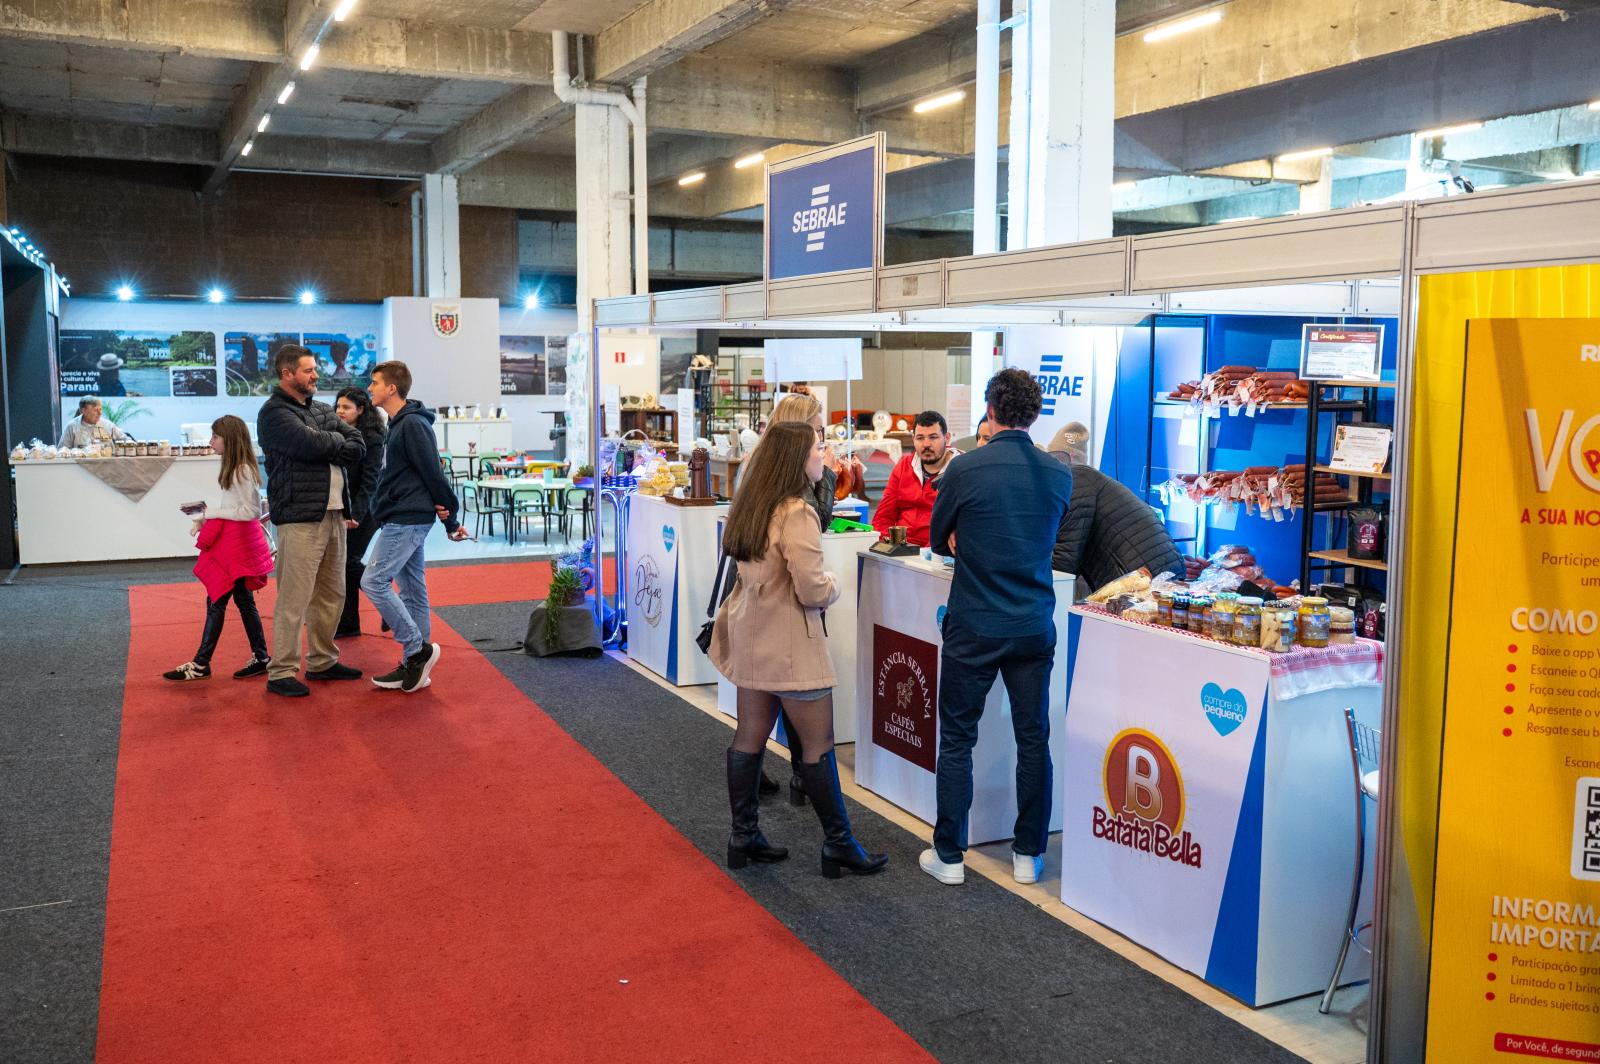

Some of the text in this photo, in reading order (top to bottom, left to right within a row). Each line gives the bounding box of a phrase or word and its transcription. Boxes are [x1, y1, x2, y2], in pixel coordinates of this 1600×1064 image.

[792, 202, 847, 233] SEBRAE
[1581, 344, 1600, 362] R
[60, 382, 99, 392] Paraná
[1031, 375, 1084, 396] BRAE
[1520, 508, 1531, 524] A
[1538, 508, 1567, 525] SUA
[1541, 552, 1600, 568] Participe
[1511, 606, 1598, 635] COMO
[1532, 644, 1561, 657] Baixe
[1563, 649, 1571, 657] o
[1572, 649, 1595, 660] app
[1530, 664, 1577, 678] Escaneie
[907, 655, 931, 719] SERRANA
[1529, 684, 1554, 697] Faça
[1556, 687, 1575, 697] seu
[1204, 694, 1244, 713] compra do
[1527, 703, 1583, 718] Apresente
[1584, 709, 1592, 718] o
[891, 712, 915, 731] CAFÉS
[1204, 704, 1244, 722] pequeno
[884, 721, 922, 748] ESPECIAIS
[1526, 722, 1570, 736] Resgate
[1571, 728, 1590, 737] seu
[1123, 744, 1163, 821] B
[1492, 895, 1600, 928] INFORM
[1511, 956, 1577, 973] Participação
[1510, 974, 1556, 990] Limitado
[1558, 982, 1566, 991] a
[1568, 981, 1573, 991] 1
[1509, 993, 1548, 1008] Brindes
[1550, 999, 1590, 1013] sujeitos
[1506, 1037, 1522, 1049] Por
[1524, 1039, 1549, 1054] Você,
[1551, 1043, 1564, 1054] de
